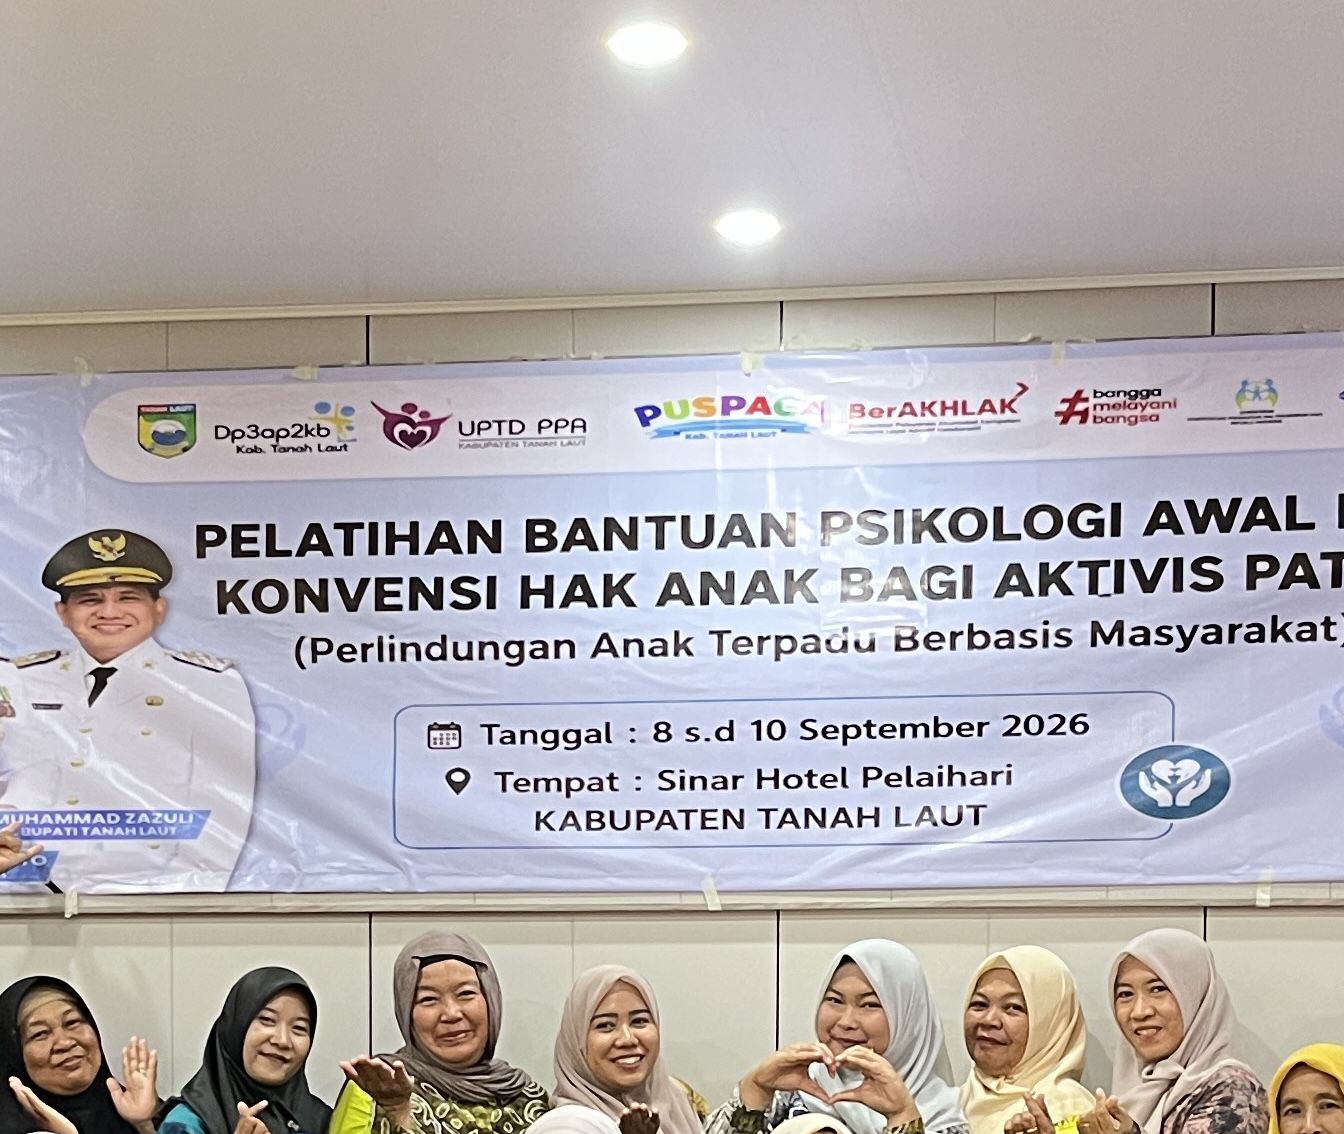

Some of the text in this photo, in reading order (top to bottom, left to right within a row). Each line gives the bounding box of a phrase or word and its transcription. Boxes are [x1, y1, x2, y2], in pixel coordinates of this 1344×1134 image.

[1093, 387, 1162, 401] bangga
[1093, 398, 1177, 412] melayani
[849, 398, 1019, 420] BerAKHLAK
[1093, 412, 1160, 427] bangsa
[214, 422, 331, 444] Dp3ap2kb
[458, 417, 587, 437] UPTD PPA
[195, 519, 502, 559] PELATIHAN
[525, 512, 793, 554] BANTUAN
[821, 503, 1122, 546] PSIKOLOGI
[1142, 494, 1316, 537] AWAL
[216, 575, 497, 615] KONVENSI
[519, 572, 638, 610] HAK
[654, 568, 819, 608] ANAK
[840, 564, 974, 601] BAGI
[993, 555, 1225, 599] AKTIVIS
[294, 633, 576, 670] (Perlindungan
[590, 629, 694, 659] Anak
[708, 626, 876, 662] Terpadu
[894, 619, 1073, 652] Berbasis
[479, 721, 613, 751] Tanggal
[652, 720, 673, 743] 8
[685, 719, 735, 743] s.d
[750, 719, 787, 742] 10
[799, 715, 991, 747] September
[1001, 712, 1090, 737] 2026
[493, 771, 620, 799] Tempat
[657, 769, 745, 792] Sinar
[756, 766, 849, 790] Hotel
[862, 763, 1013, 789] Pelaihari
[125, 812, 194, 825] ZAZULI
[535, 804, 988, 832] KABUPATEN TANAH LAUT
[81, 826, 136, 836] TANAH
[139, 826, 177, 836] LAUT
